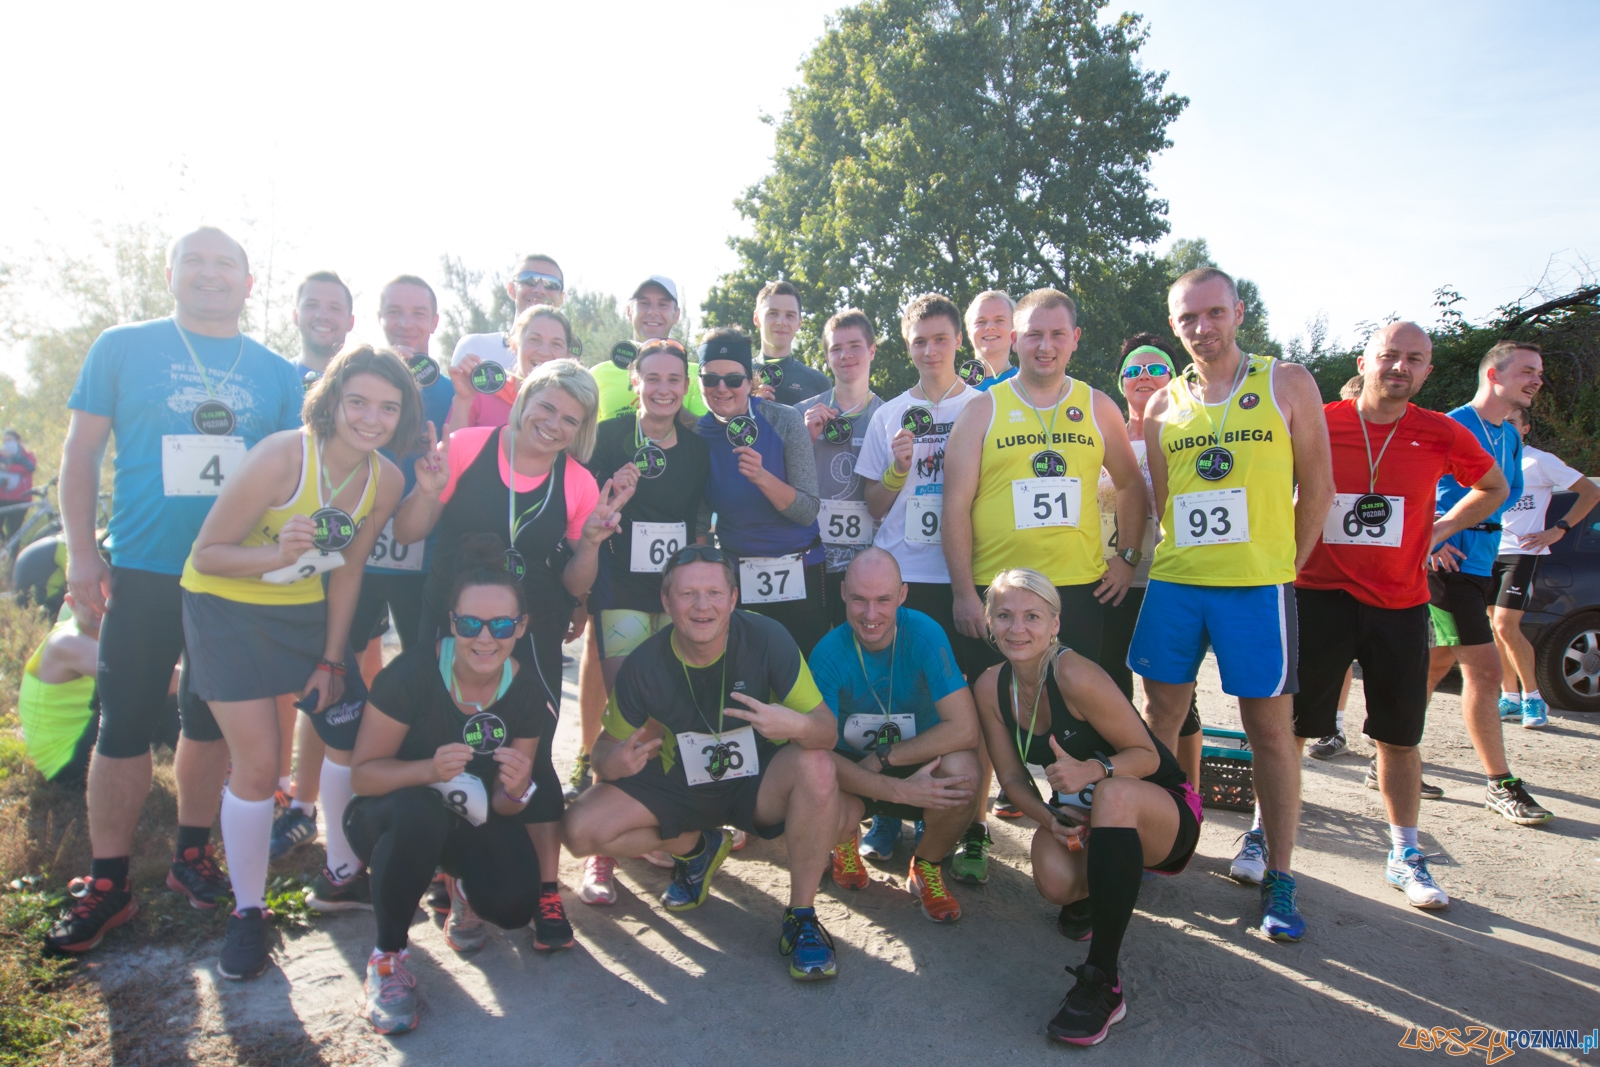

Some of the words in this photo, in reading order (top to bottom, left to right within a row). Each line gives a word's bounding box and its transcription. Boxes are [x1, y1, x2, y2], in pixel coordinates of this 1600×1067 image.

[996, 431, 1047, 450] LUBOŃ
[1052, 433, 1095, 448] BIEGA
[1168, 431, 1218, 454] LUBOŃ
[1224, 429, 1273, 443] BIEGA
[199, 454, 225, 487] 4
[1033, 491, 1069, 520] 51
[828, 514, 861, 538] 58
[1188, 506, 1232, 538] 93
[757, 569, 790, 596] 37
